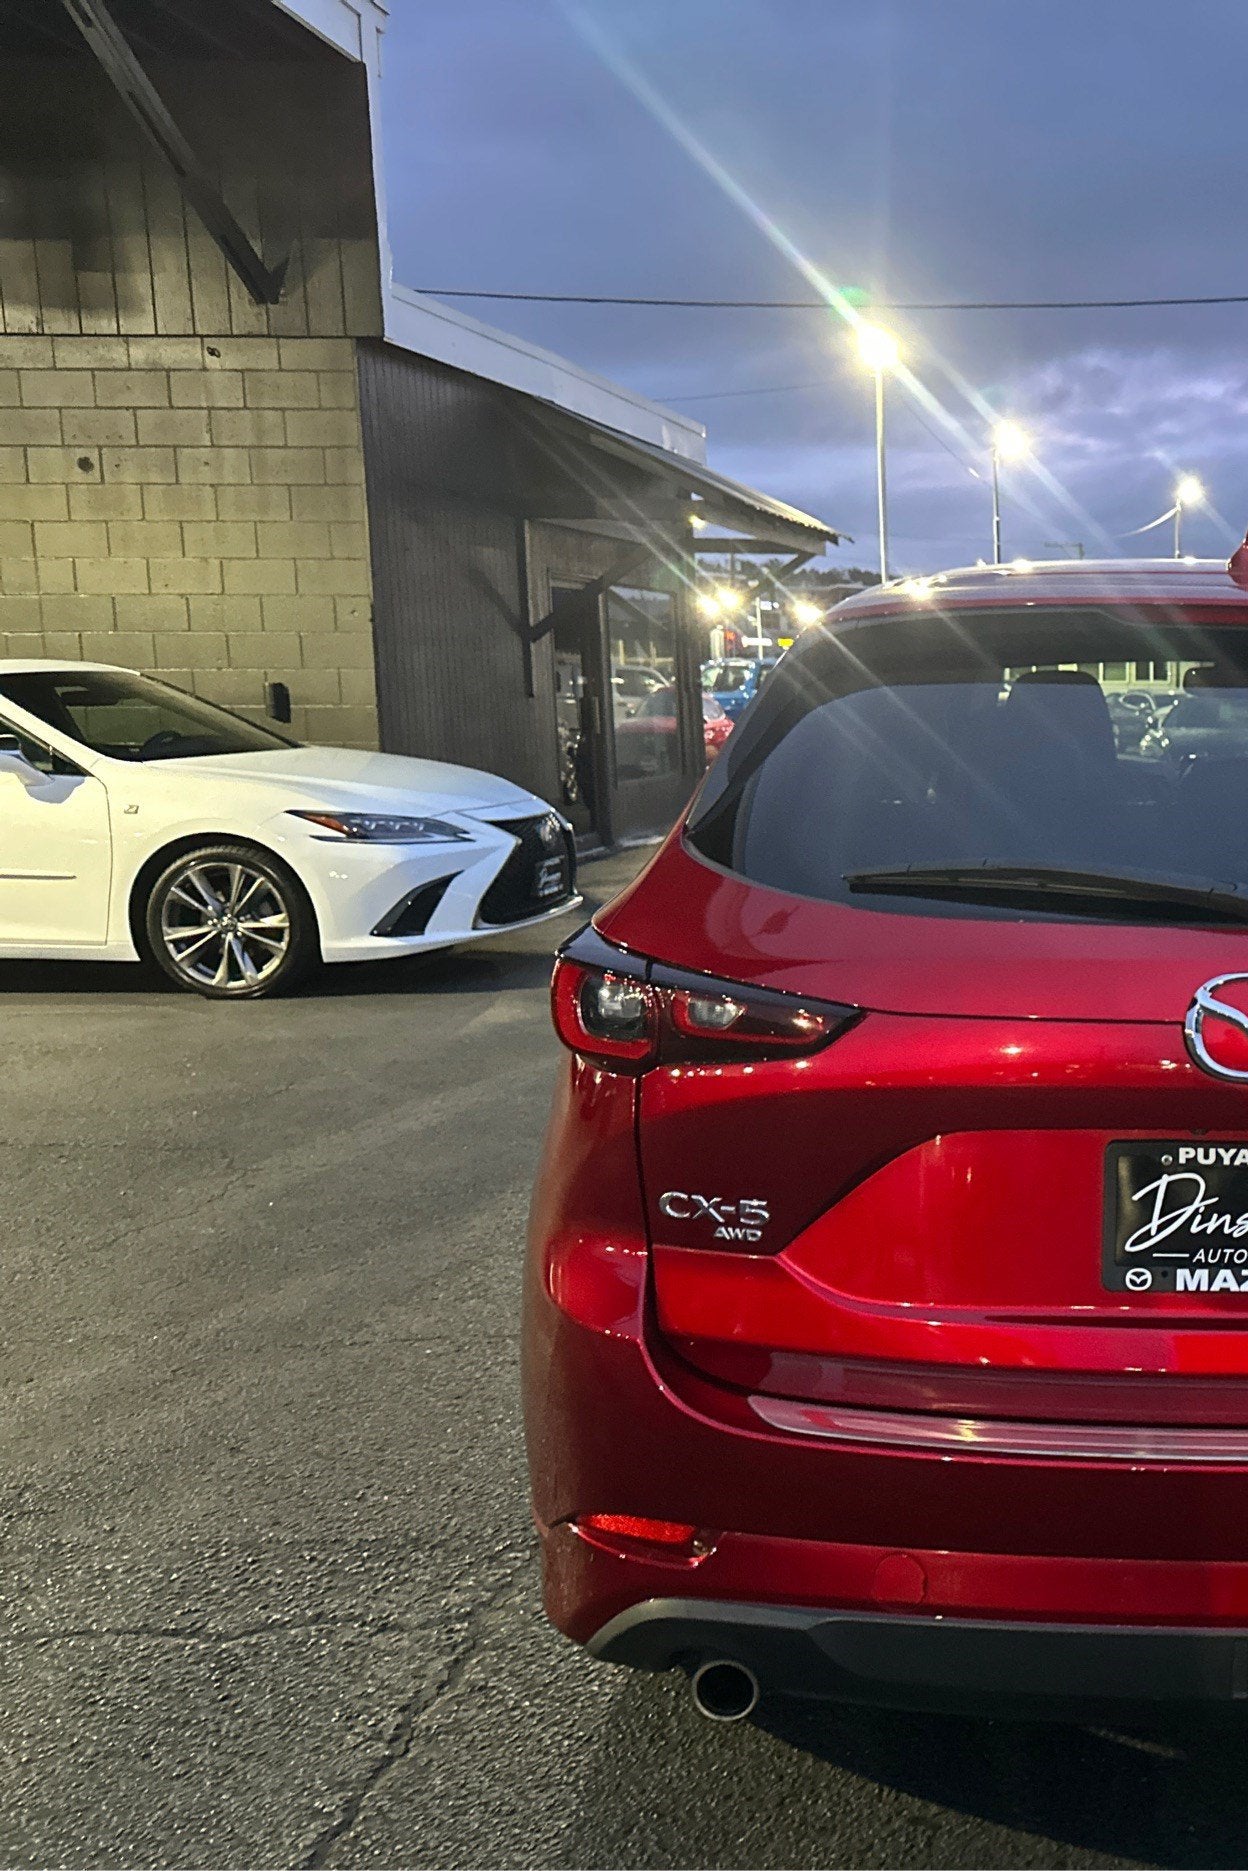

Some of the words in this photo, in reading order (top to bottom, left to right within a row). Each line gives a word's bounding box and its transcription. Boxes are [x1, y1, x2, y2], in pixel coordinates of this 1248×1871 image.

[658, 1191, 770, 1225] CX-5
[713, 1226, 763, 1242] AWD
[1192, 1249, 1248, 1264] AUTO
